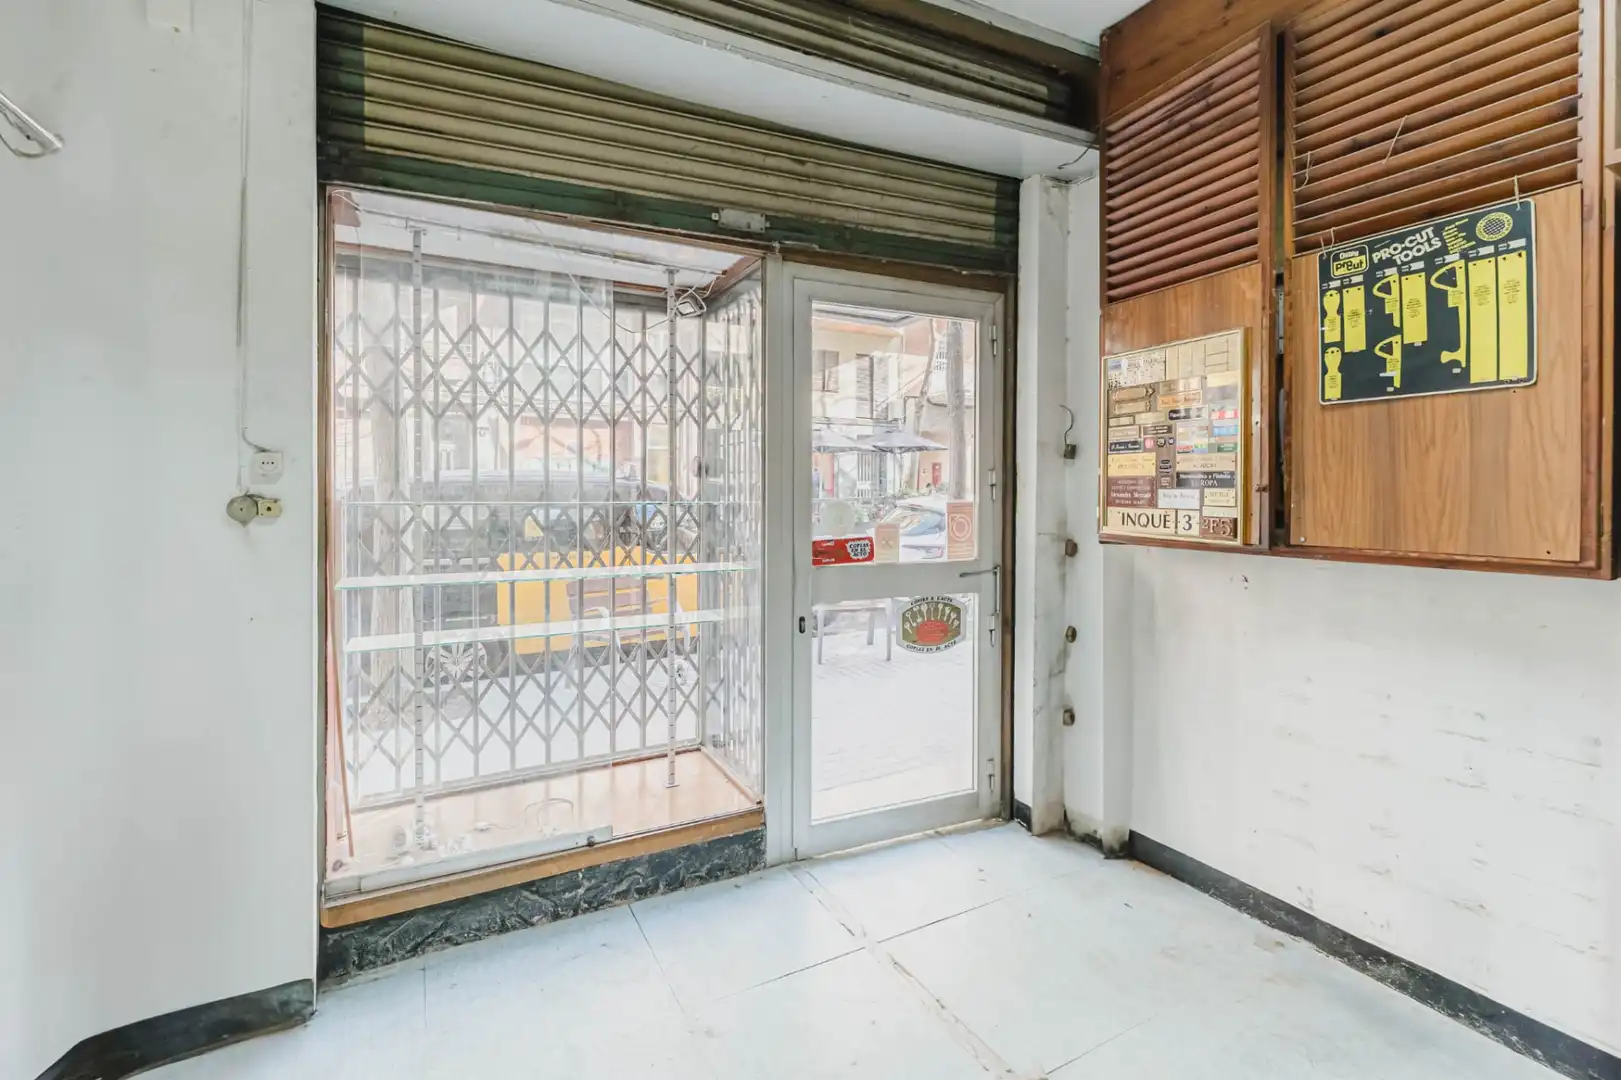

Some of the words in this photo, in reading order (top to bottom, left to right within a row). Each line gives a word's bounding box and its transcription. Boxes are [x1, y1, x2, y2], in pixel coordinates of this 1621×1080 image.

[1371, 226, 1435, 264] PRO-CUT
[1392, 236, 1442, 265] TOOLS
[1182, 514, 1192, 531] 3
